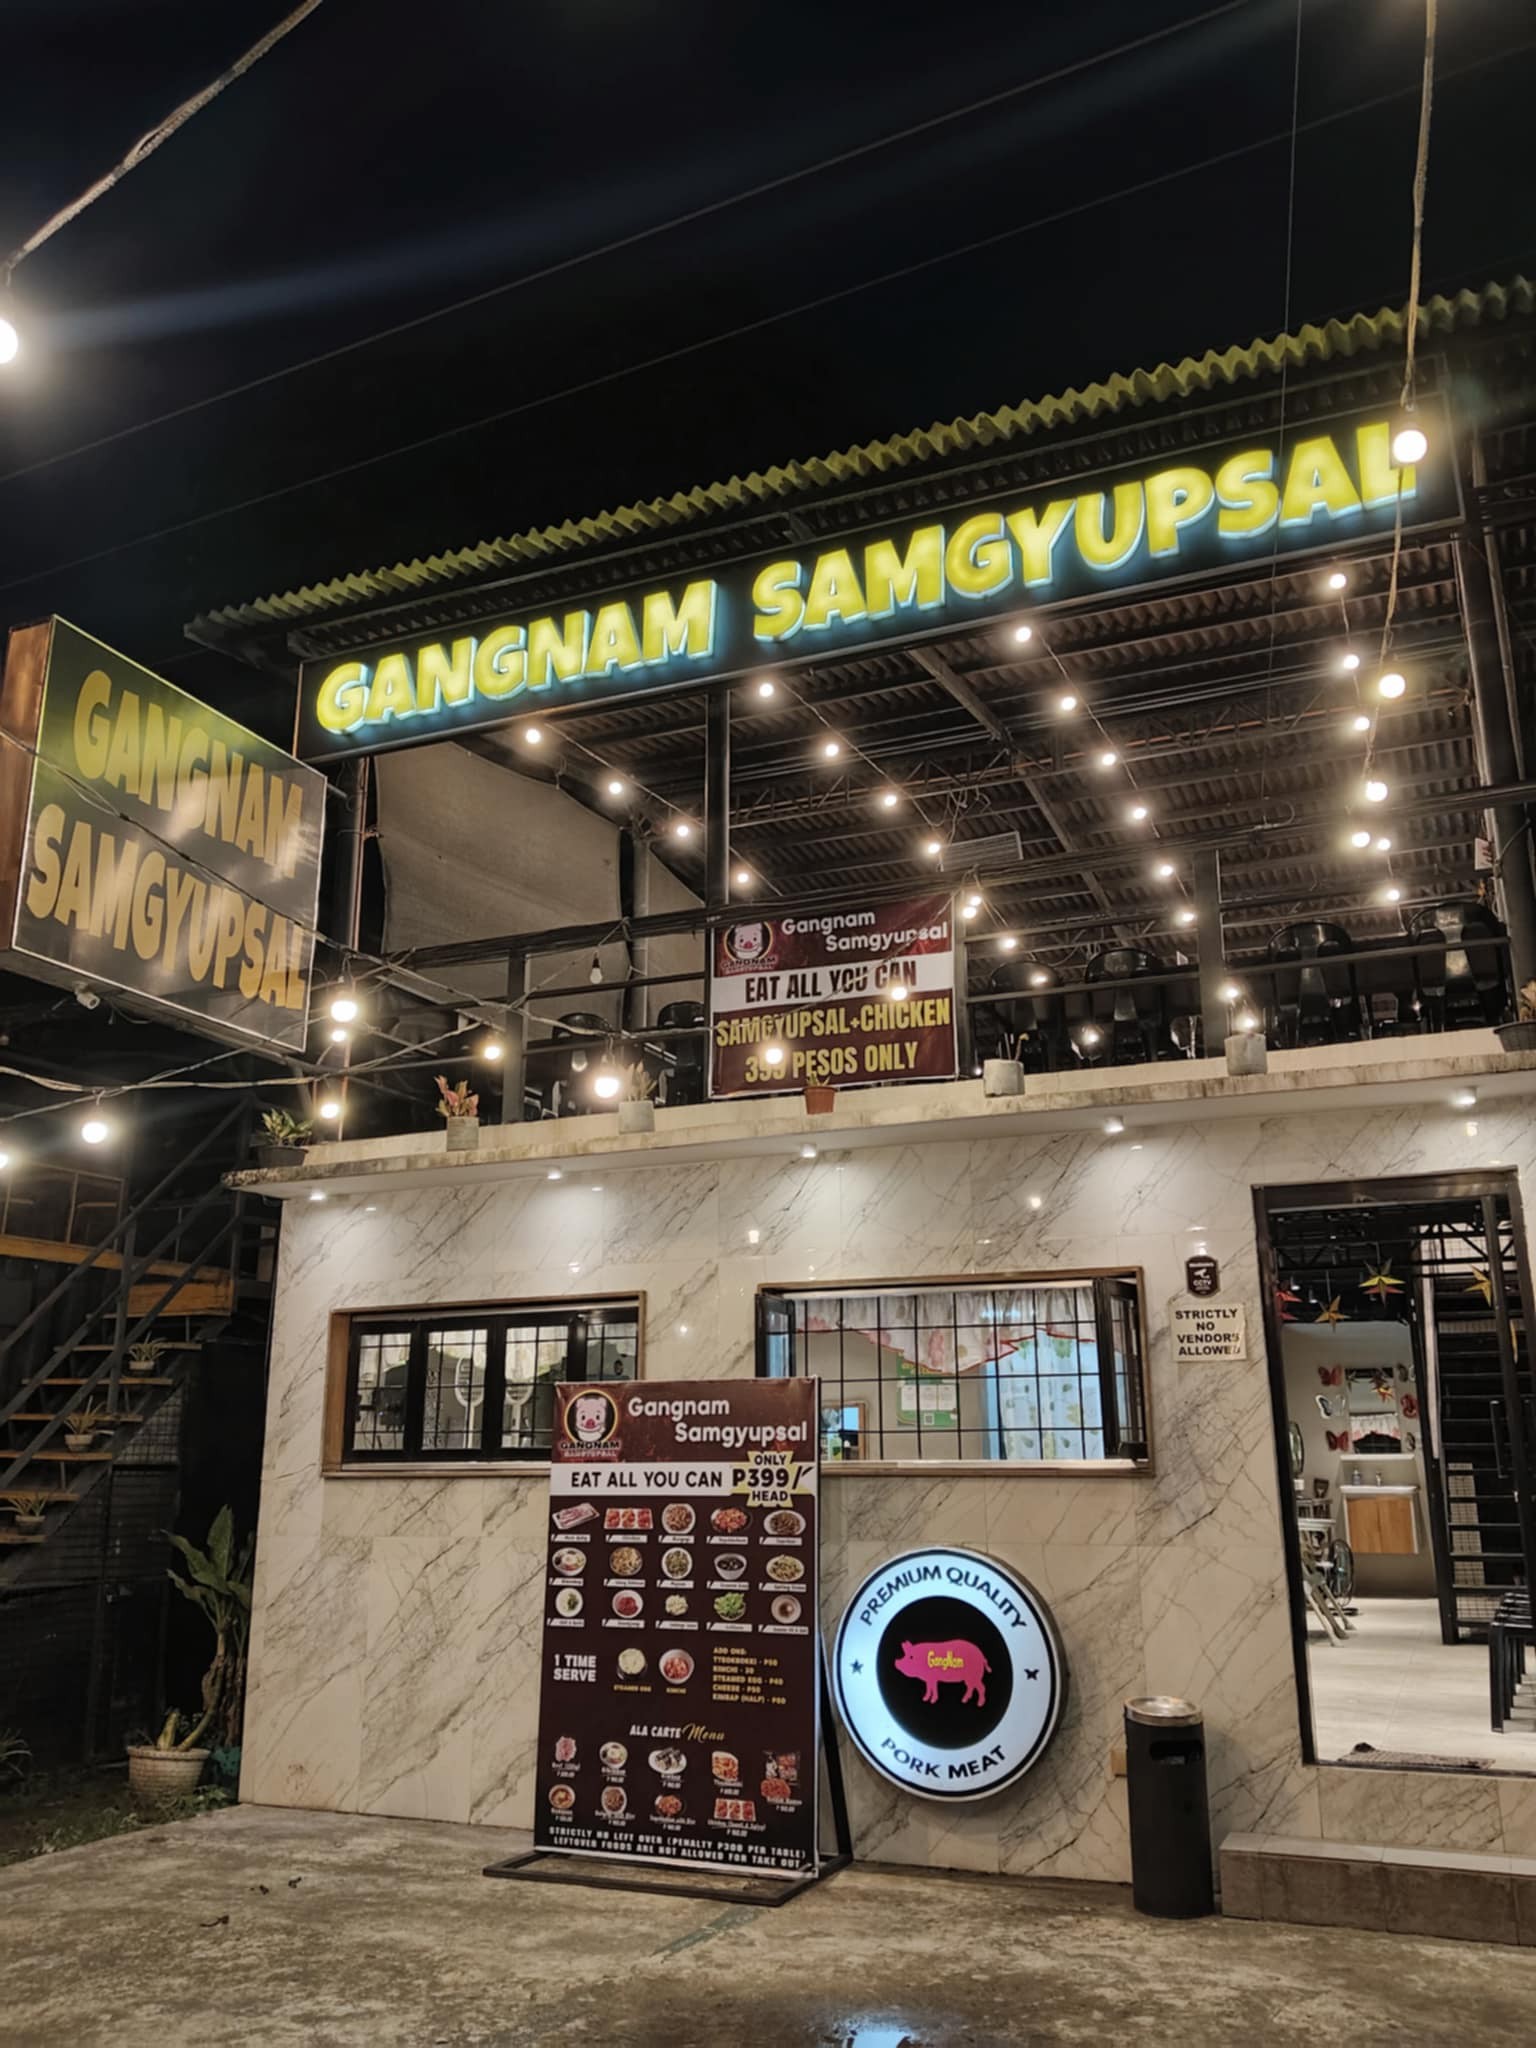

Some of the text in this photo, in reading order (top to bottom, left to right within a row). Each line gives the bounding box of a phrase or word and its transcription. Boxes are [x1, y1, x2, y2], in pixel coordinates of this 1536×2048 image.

[316, 422, 1417, 735] GANGNAM SAMGYUPSAL
[73, 669, 304, 879] GANGNAM
[26, 803, 308, 1011] SAMGYUPSAL
[781, 911, 876, 936] Gangnam
[825, 921, 948, 952] Samgyupsal
[745, 960, 917, 1004] EAT ALL YOU CAN
[793, 1046, 858, 1078] PESOS
[864, 1041, 919, 1071] ONLY
[1175, 1308, 1239, 1320] STRICTLY
[1196, 1321, 1216, 1331] NO
[628, 1396, 730, 1421] Gangnam
[675, 1421, 807, 1447] Samgyupsal
[754, 1454, 787, 1465] ONLY
[571, 1471, 723, 1488] EAT ALL YOU CAN
[752, 1490, 788, 1502] HEAD
[860, 1565, 1027, 1629] PREMIUM QUALITY
[554, 1654, 597, 1668] 1 TIME
[553, 1668, 597, 1682] SERVE
[629, 1723, 725, 1743] ALA CARTE Menu
[881, 1737, 1007, 1780] PORK MEAT
[549, 1826, 592, 1838] STRICTLY
[596, 1831, 610, 1839] NO
[613, 1832, 634, 1841] LEFT
[638, 1834, 662, 1844] OVER
[666, 1836, 713, 1849] (PENALTY
[748, 1844, 766, 1855] PER
[554, 1837, 801, 1869] LEFTOVER FOODS ARE NOT ALLOWED FOR TAKE OUT
